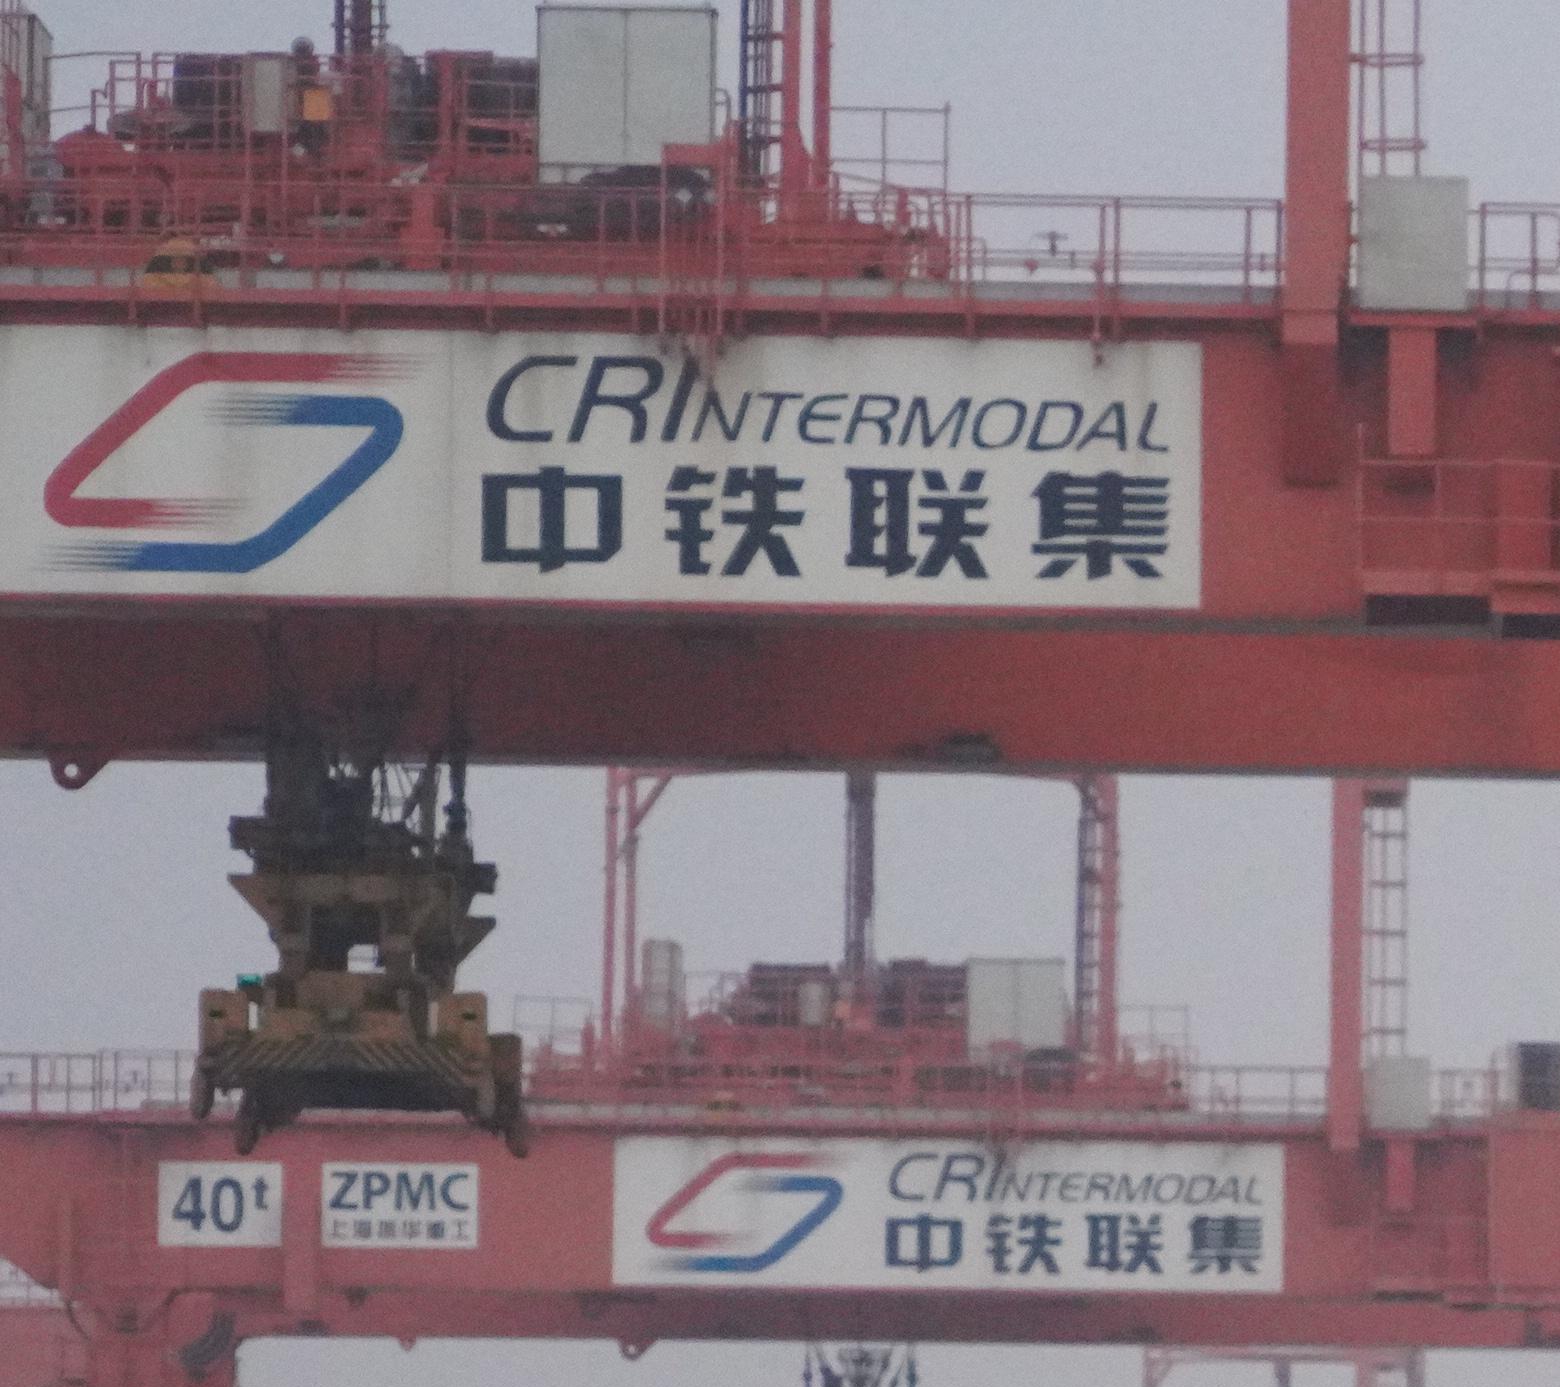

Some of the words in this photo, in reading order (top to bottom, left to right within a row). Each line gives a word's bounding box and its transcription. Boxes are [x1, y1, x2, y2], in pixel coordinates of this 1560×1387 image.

[481, 465, 1170, 580] 中铁联集
[172, 1173, 269, 1234] 40t
[329, 1171, 469, 1211] ZPMC
[884, 1214, 1264, 1275] 中铁联集
